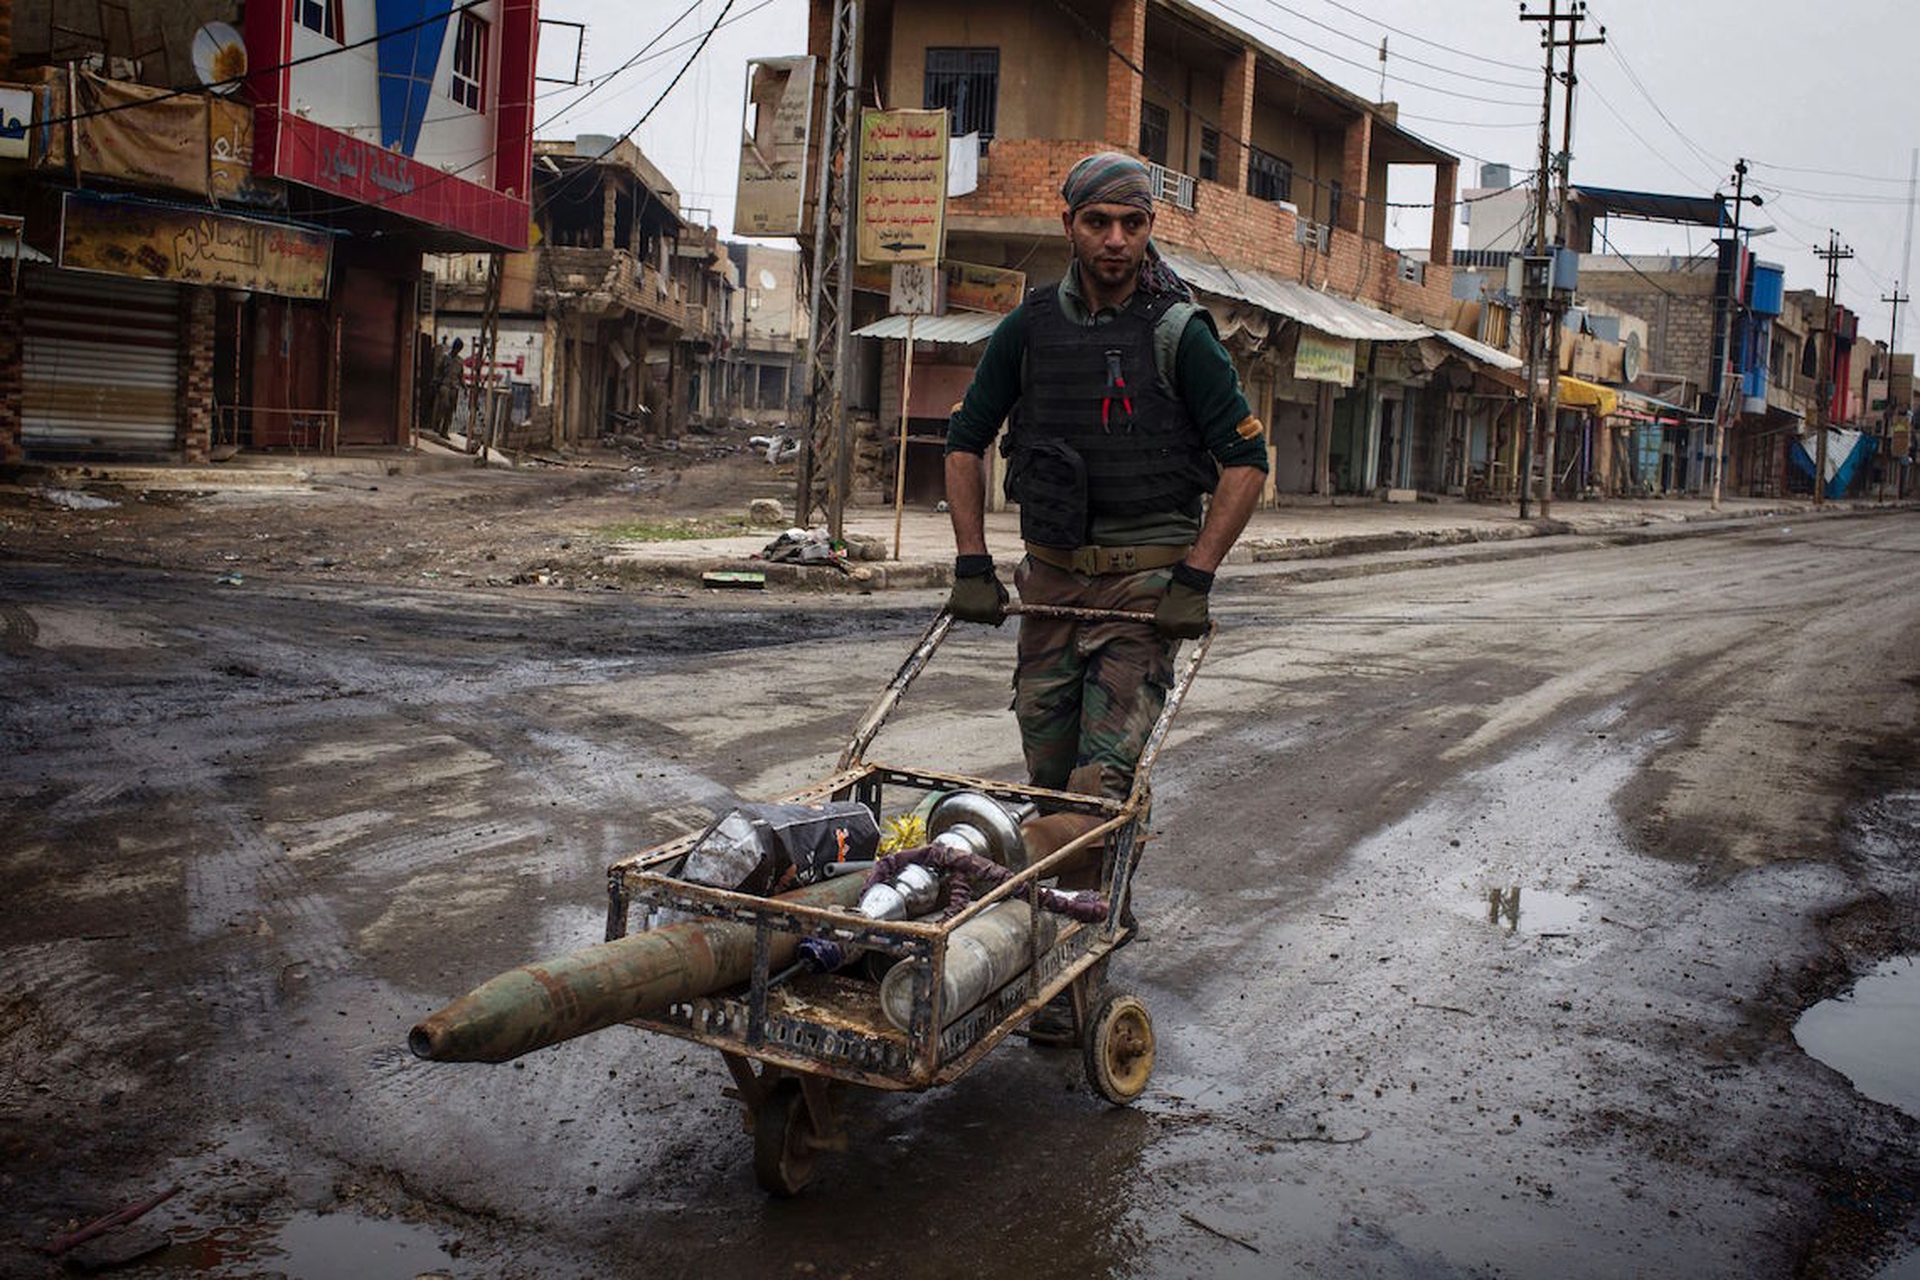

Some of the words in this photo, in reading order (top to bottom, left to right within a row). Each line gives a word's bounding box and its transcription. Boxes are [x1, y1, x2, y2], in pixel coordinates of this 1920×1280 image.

[870, 124, 903, 140] السلام
[321, 139, 358, 183] النور
[369, 147, 415, 193] مكتبة
[174, 217, 265, 271] السلام
